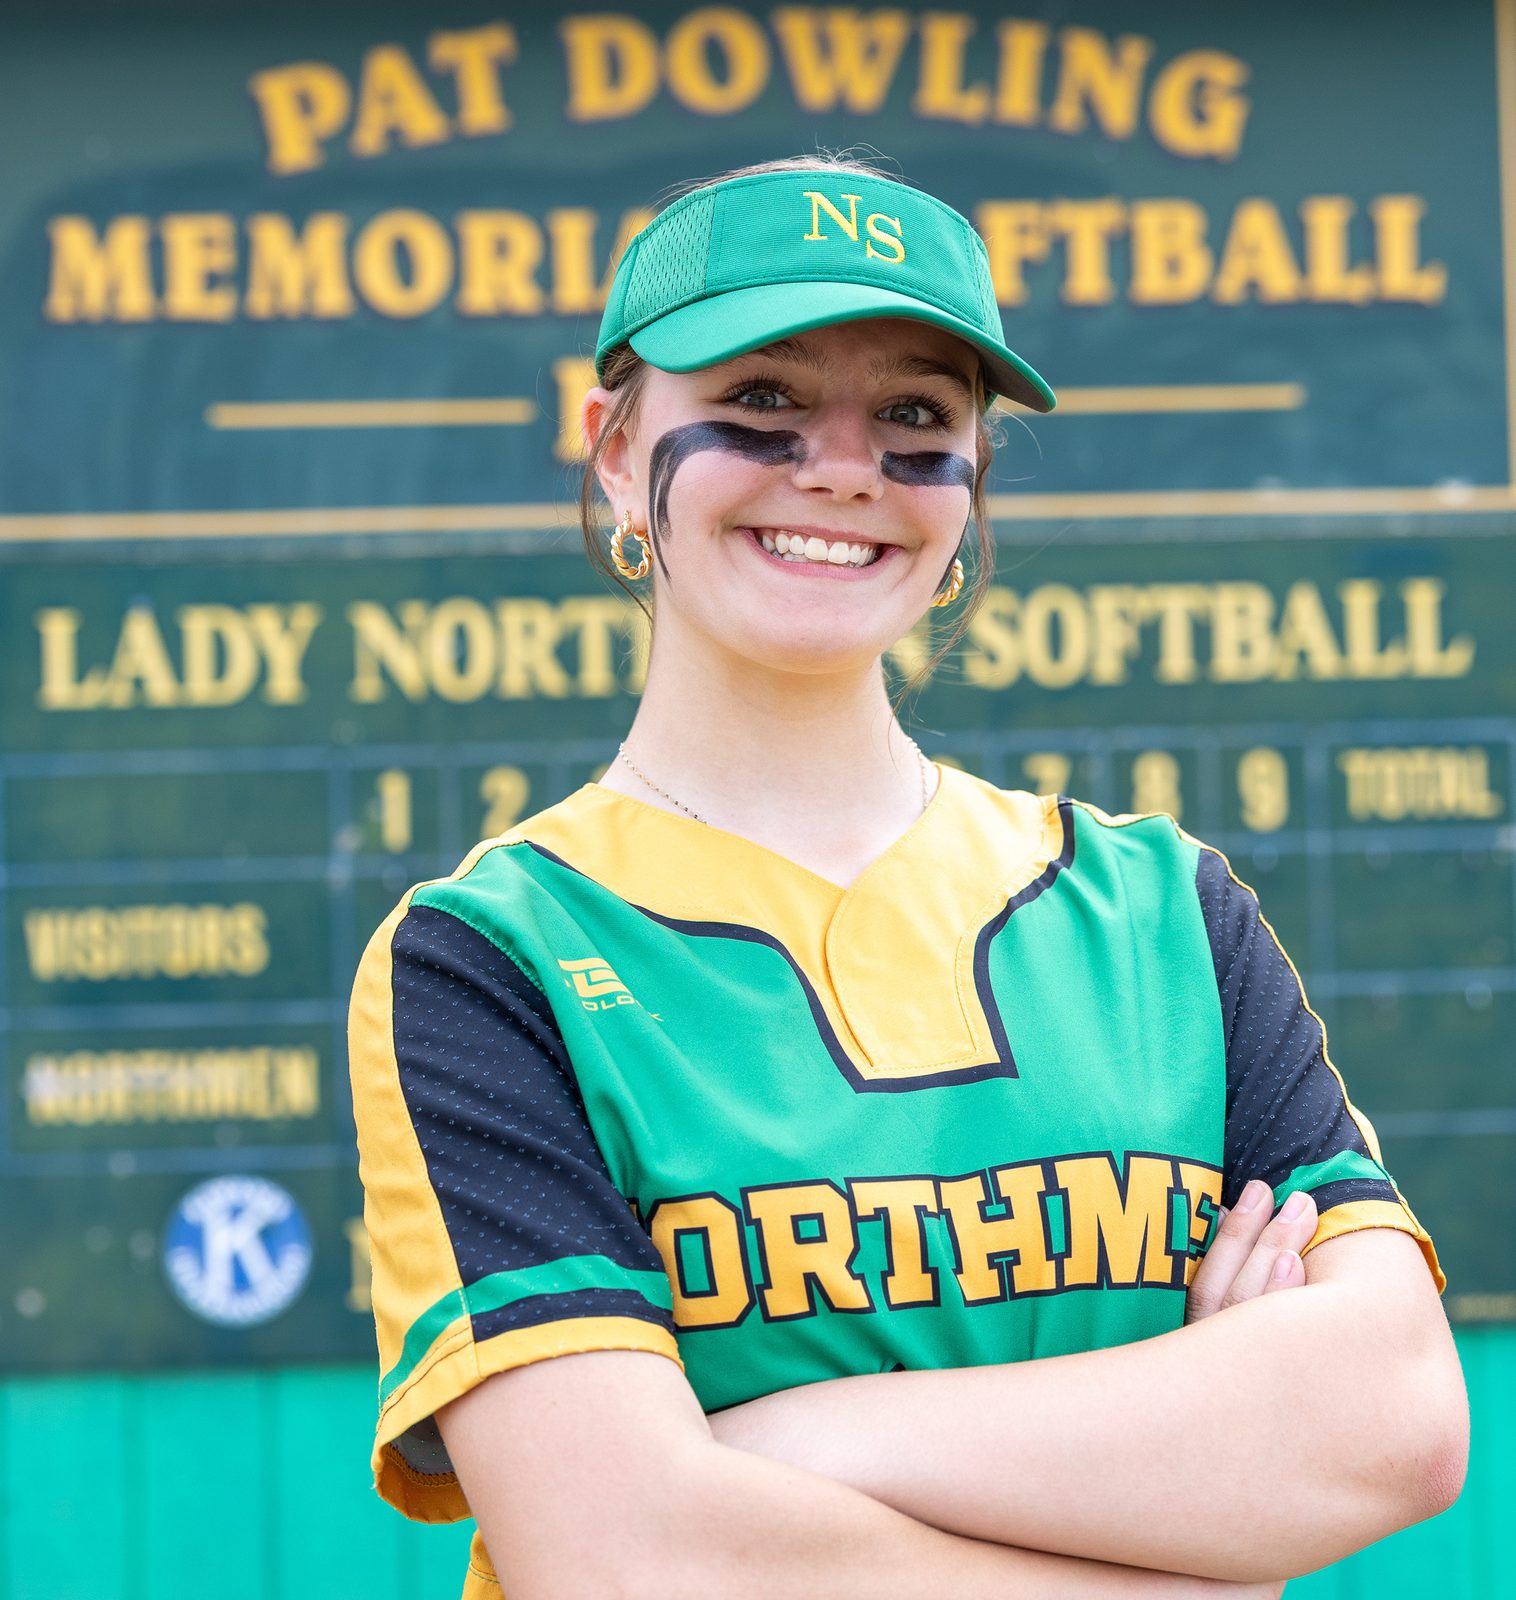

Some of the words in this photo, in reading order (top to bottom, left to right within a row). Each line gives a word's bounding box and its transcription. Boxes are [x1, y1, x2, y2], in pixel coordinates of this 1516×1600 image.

[251, 24, 516, 174] PAT
[563, 6, 1250, 160] DOWLING
[45, 209, 655, 323] MEMORI
[972, 196, 1447, 307] FTBALL
[35, 601, 323, 710] LADY
[965, 577, 1474, 690] SOFTBALL
[378, 769, 411, 852] 1
[480, 765, 530, 838] 2
